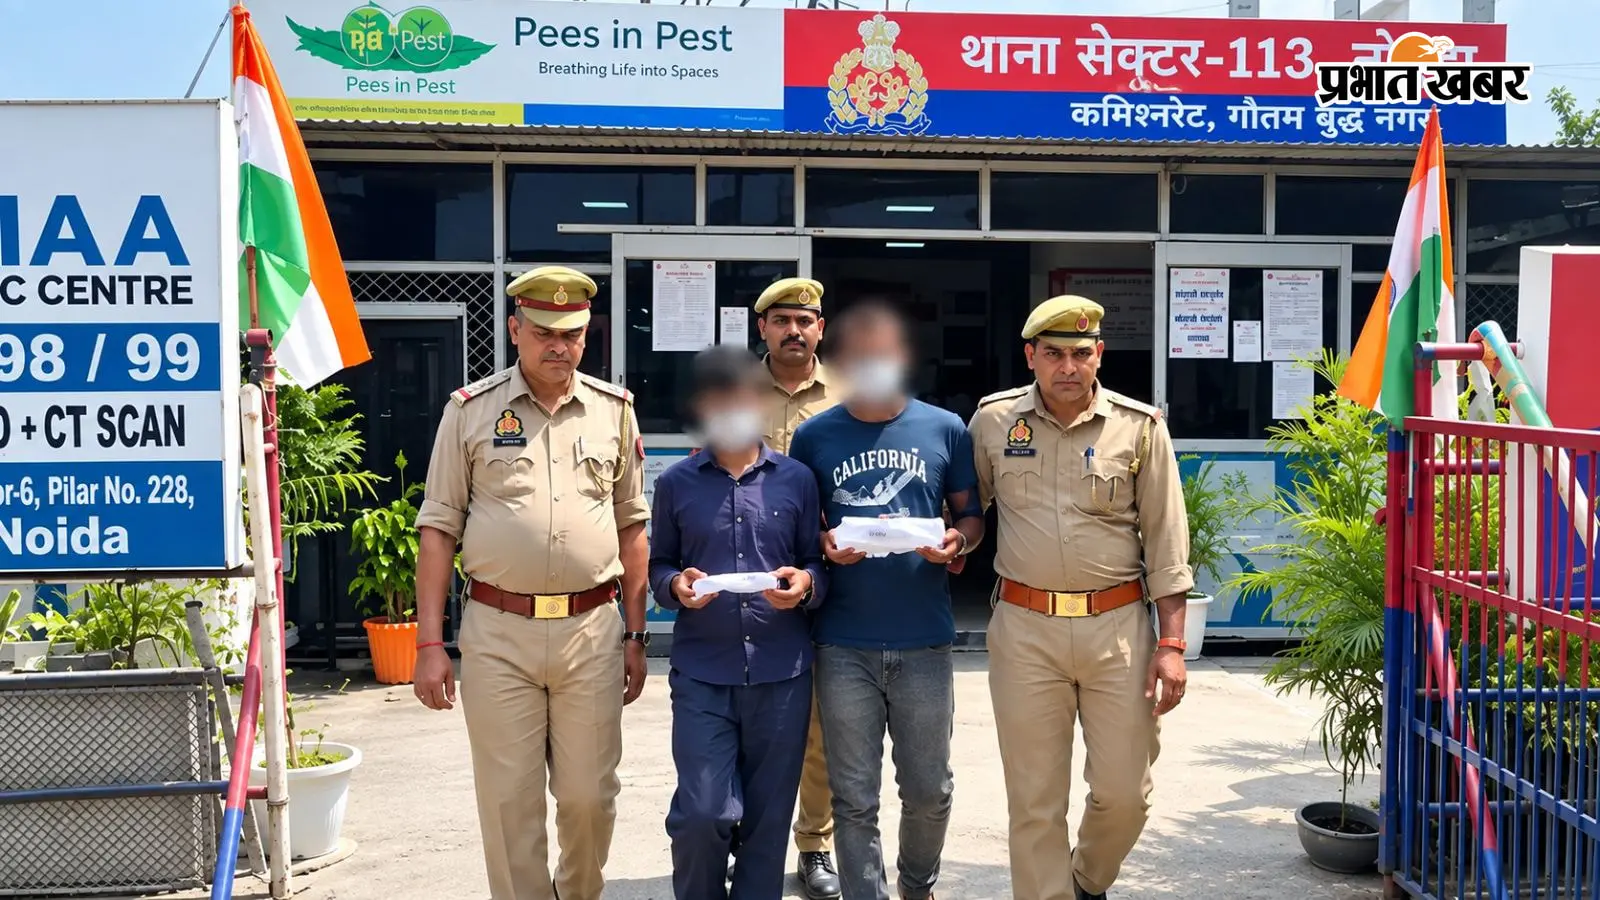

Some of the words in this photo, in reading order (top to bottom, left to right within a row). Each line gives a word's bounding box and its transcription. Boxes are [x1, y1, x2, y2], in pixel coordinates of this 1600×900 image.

[401, 29, 446, 51] Pest
[515, 16, 600, 48] Pees
[612, 19, 642, 49] in
[656, 21, 733, 52] Pest
[538, 61, 608, 79] Breathing
[611, 62, 637, 77] Life
[640, 63, 668, 77] into
[671, 64, 719, 80] Spaces
[961, 35, 1061, 75] थाना
[346, 76, 390, 93] Pees
[395, 76, 411, 93] in
[416, 78, 456, 94] Pest
[1070, 94, 1215, 132] कमिश्नरेट,
[1227, 97, 1304, 130] गौतम
[1314, 106, 1366, 138] बुद्ध
[37, 274, 193, 306] CENTRE
[0, 333, 66, 382] 98
[86, 333, 107, 382] /
[126, 333, 200, 382] 99
[44, 404, 87, 448] CT
[96, 404, 186, 448] SCAN
[833, 448, 928, 487] CALIFORNIA
[48, 475, 99, 505] Pilar
[104, 475, 141, 505] No.
[147, 474, 195, 510] 228,
[0, 515, 129, 556] Noida
